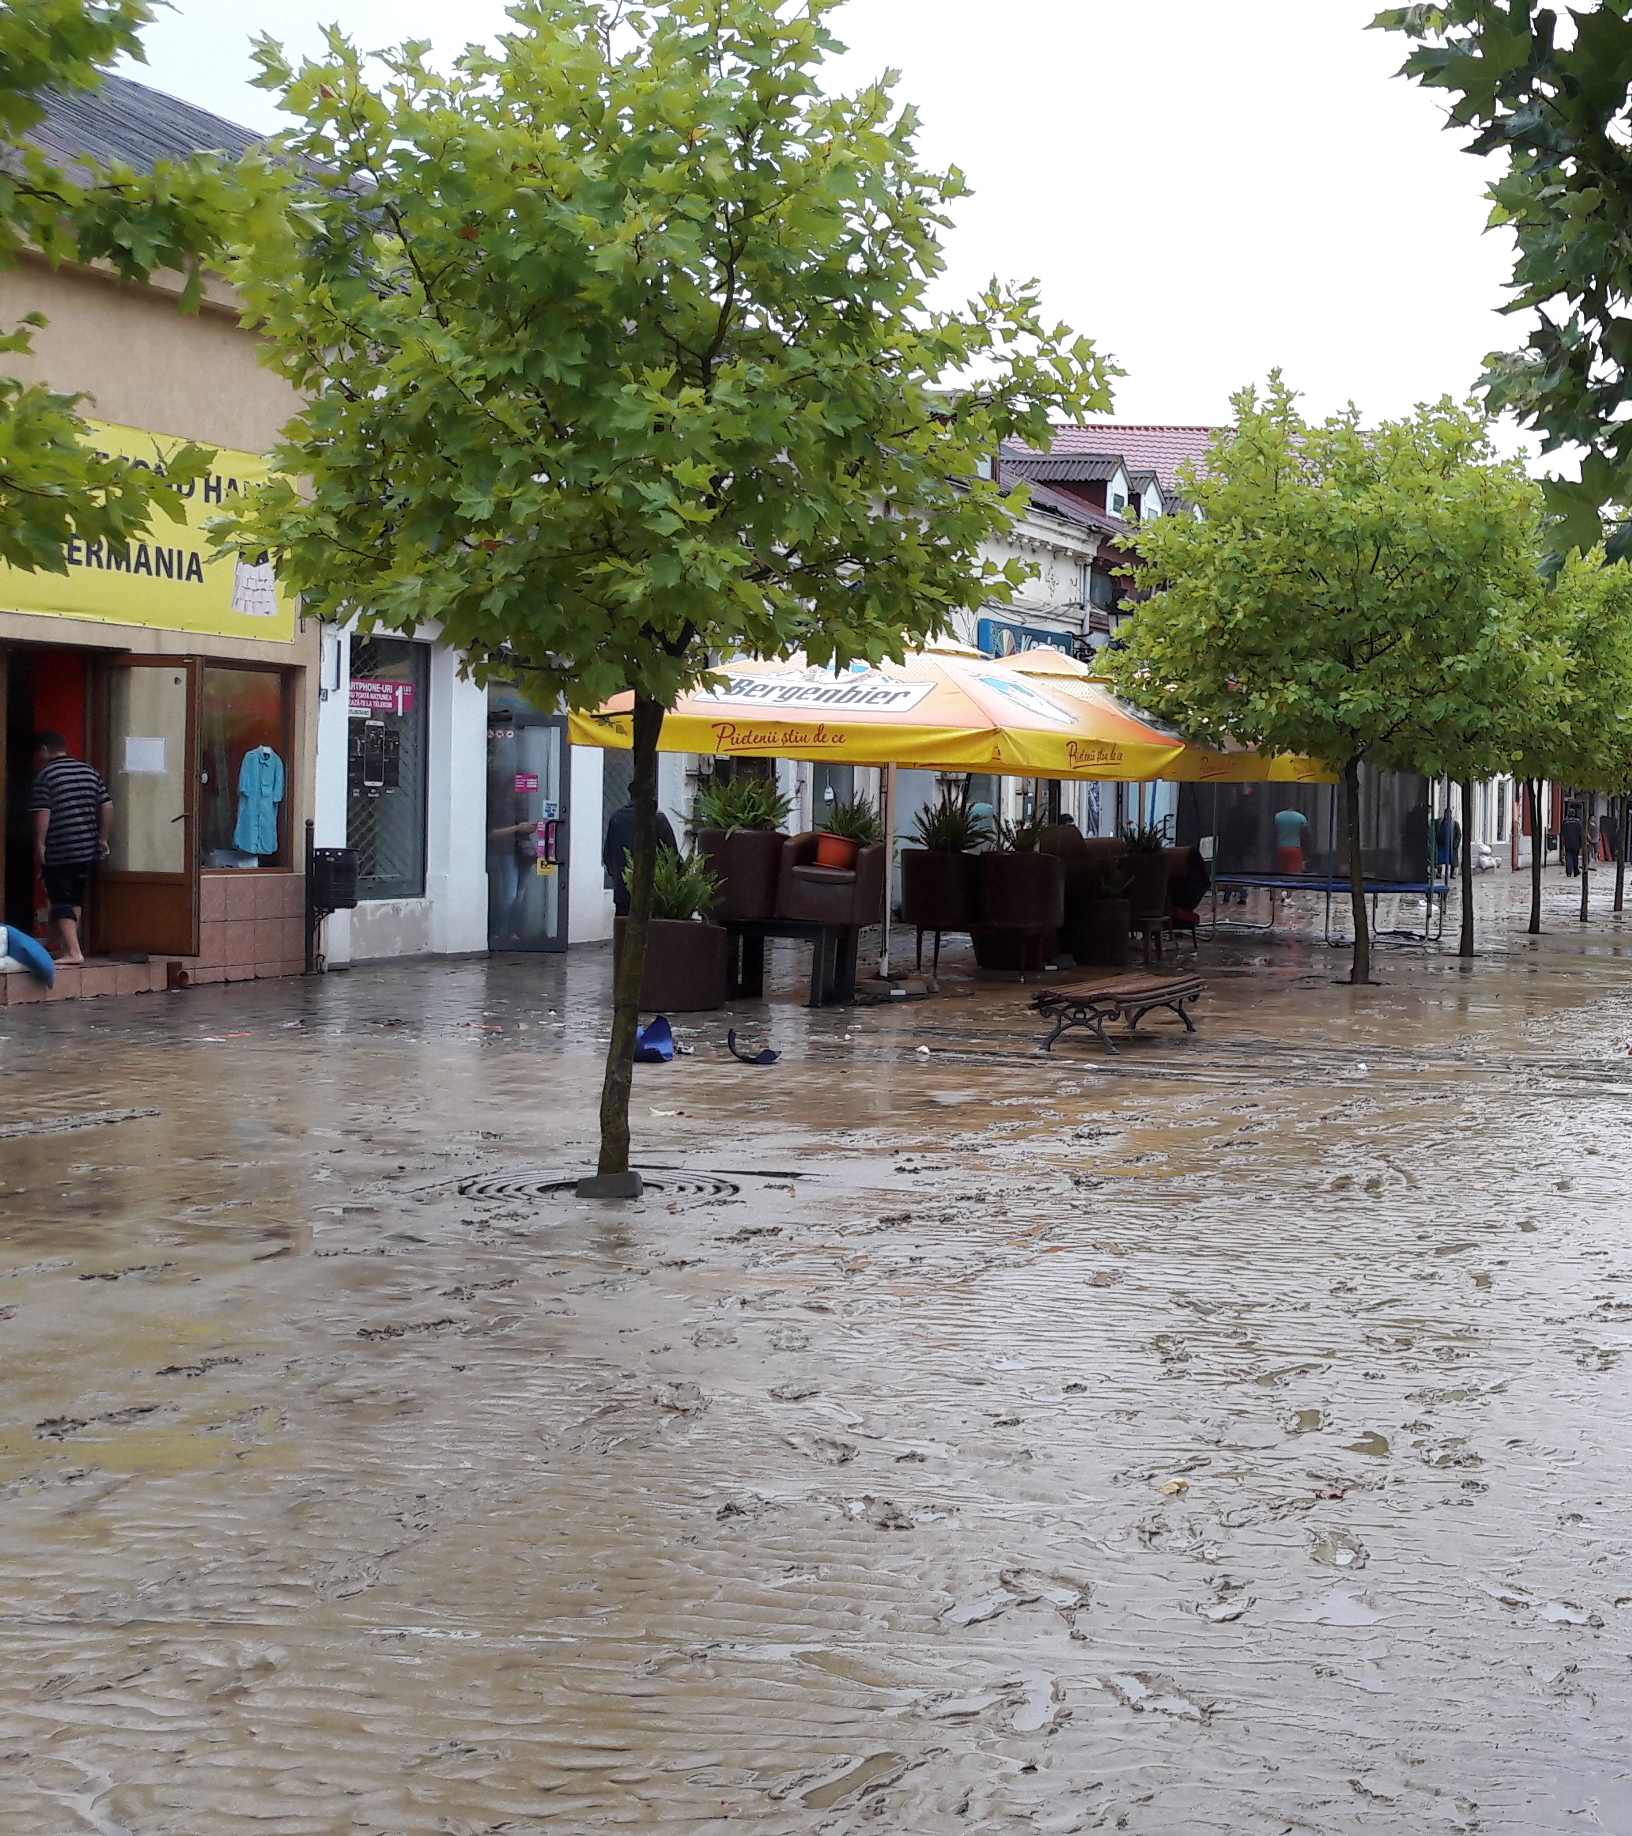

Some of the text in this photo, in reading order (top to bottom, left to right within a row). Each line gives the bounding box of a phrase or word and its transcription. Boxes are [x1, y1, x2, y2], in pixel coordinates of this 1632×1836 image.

[67, 533, 204, 584] ERMANIA
[395, 685, 403, 717] 1
[724, 678, 912, 706] Bergenbier
[813, 723, 829, 744] de
[832, 732, 847, 744] ce
